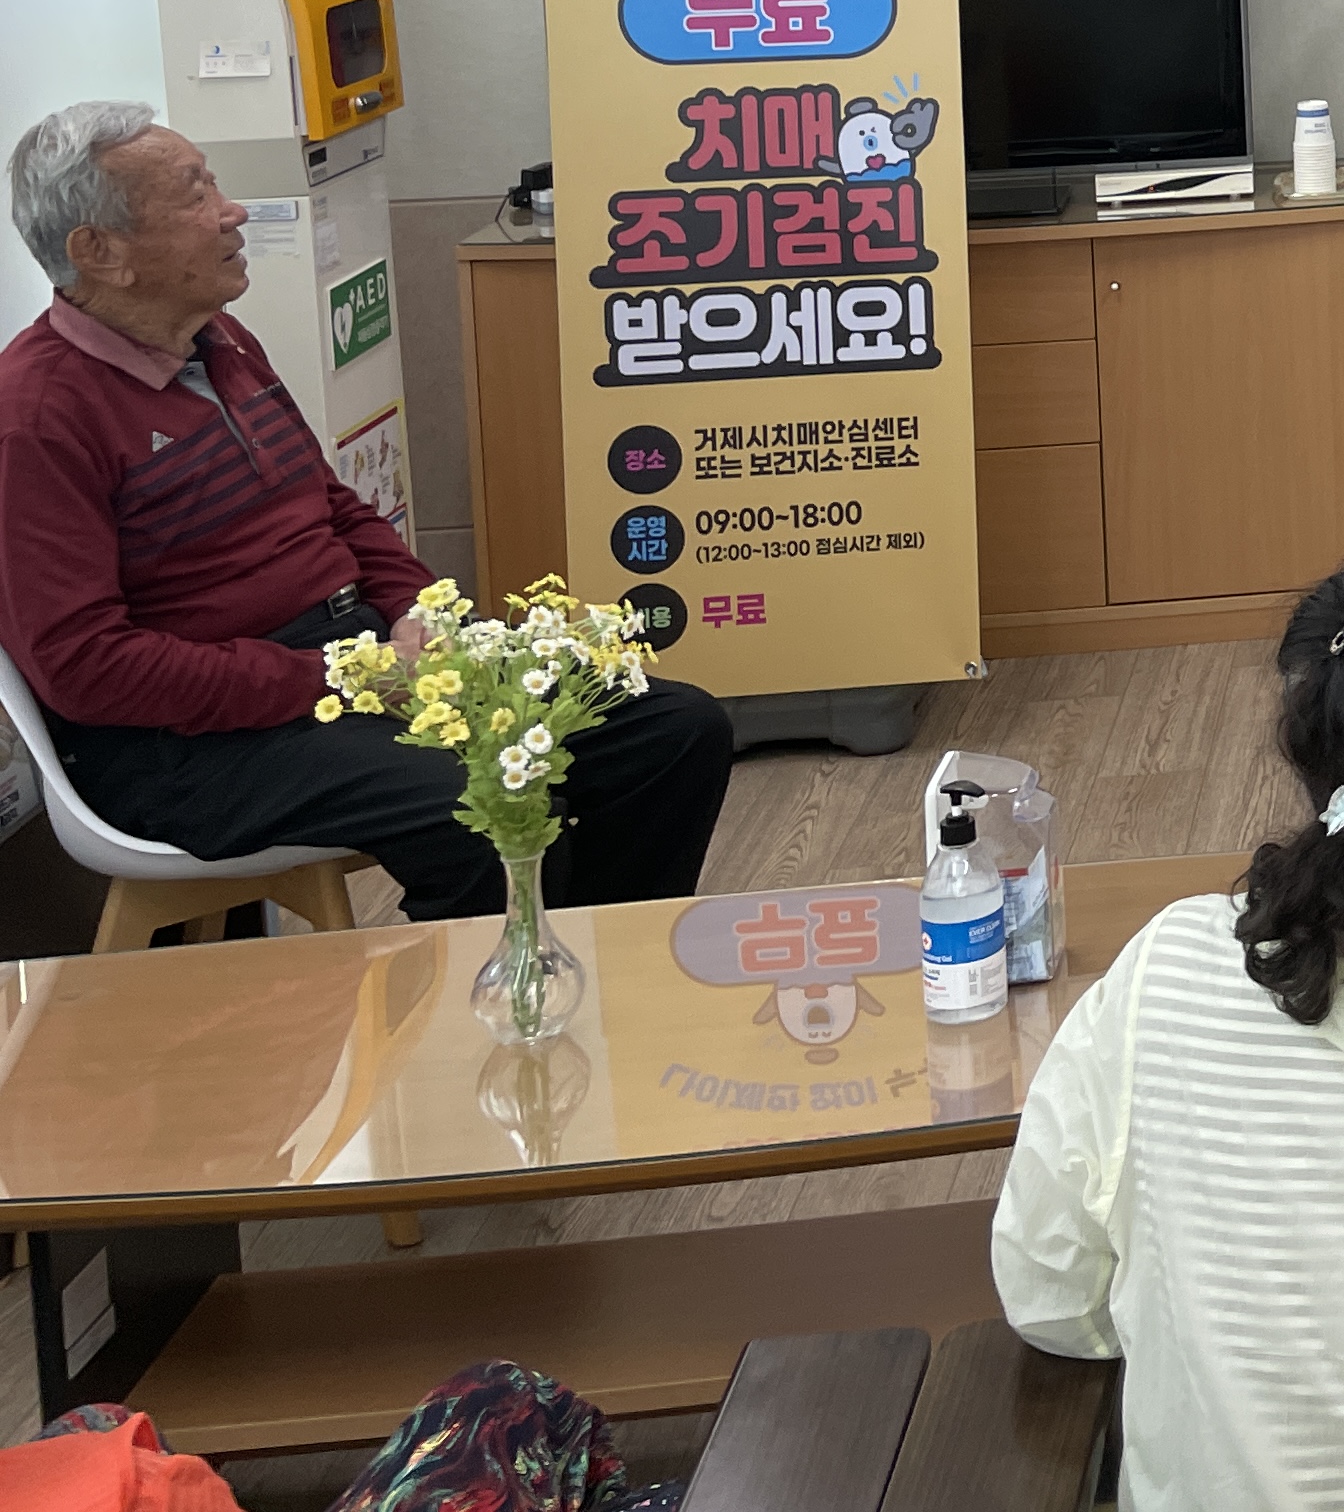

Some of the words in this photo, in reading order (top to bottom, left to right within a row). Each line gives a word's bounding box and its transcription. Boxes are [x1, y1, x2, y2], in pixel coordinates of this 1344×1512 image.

[687, 91, 834, 172] 치매
[616, 184, 918, 273] 조기검진
[356, 272, 386, 313] AED
[612, 283, 927, 376] 받으세요!
[694, 417, 919, 452] 거제시치매안심센터
[625, 449, 667, 472] 장소
[695, 452, 742, 480] 또는
[627, 516, 667, 539] 운영
[695, 500, 863, 536] 09:00~18:00
[627, 539, 668, 562] 시간
[696, 540, 811, 564] (12:00~13:00
[816, 533, 881, 556] 점심시간
[886, 531, 925, 551] 제외)
[702, 593, 767, 629] 무료
